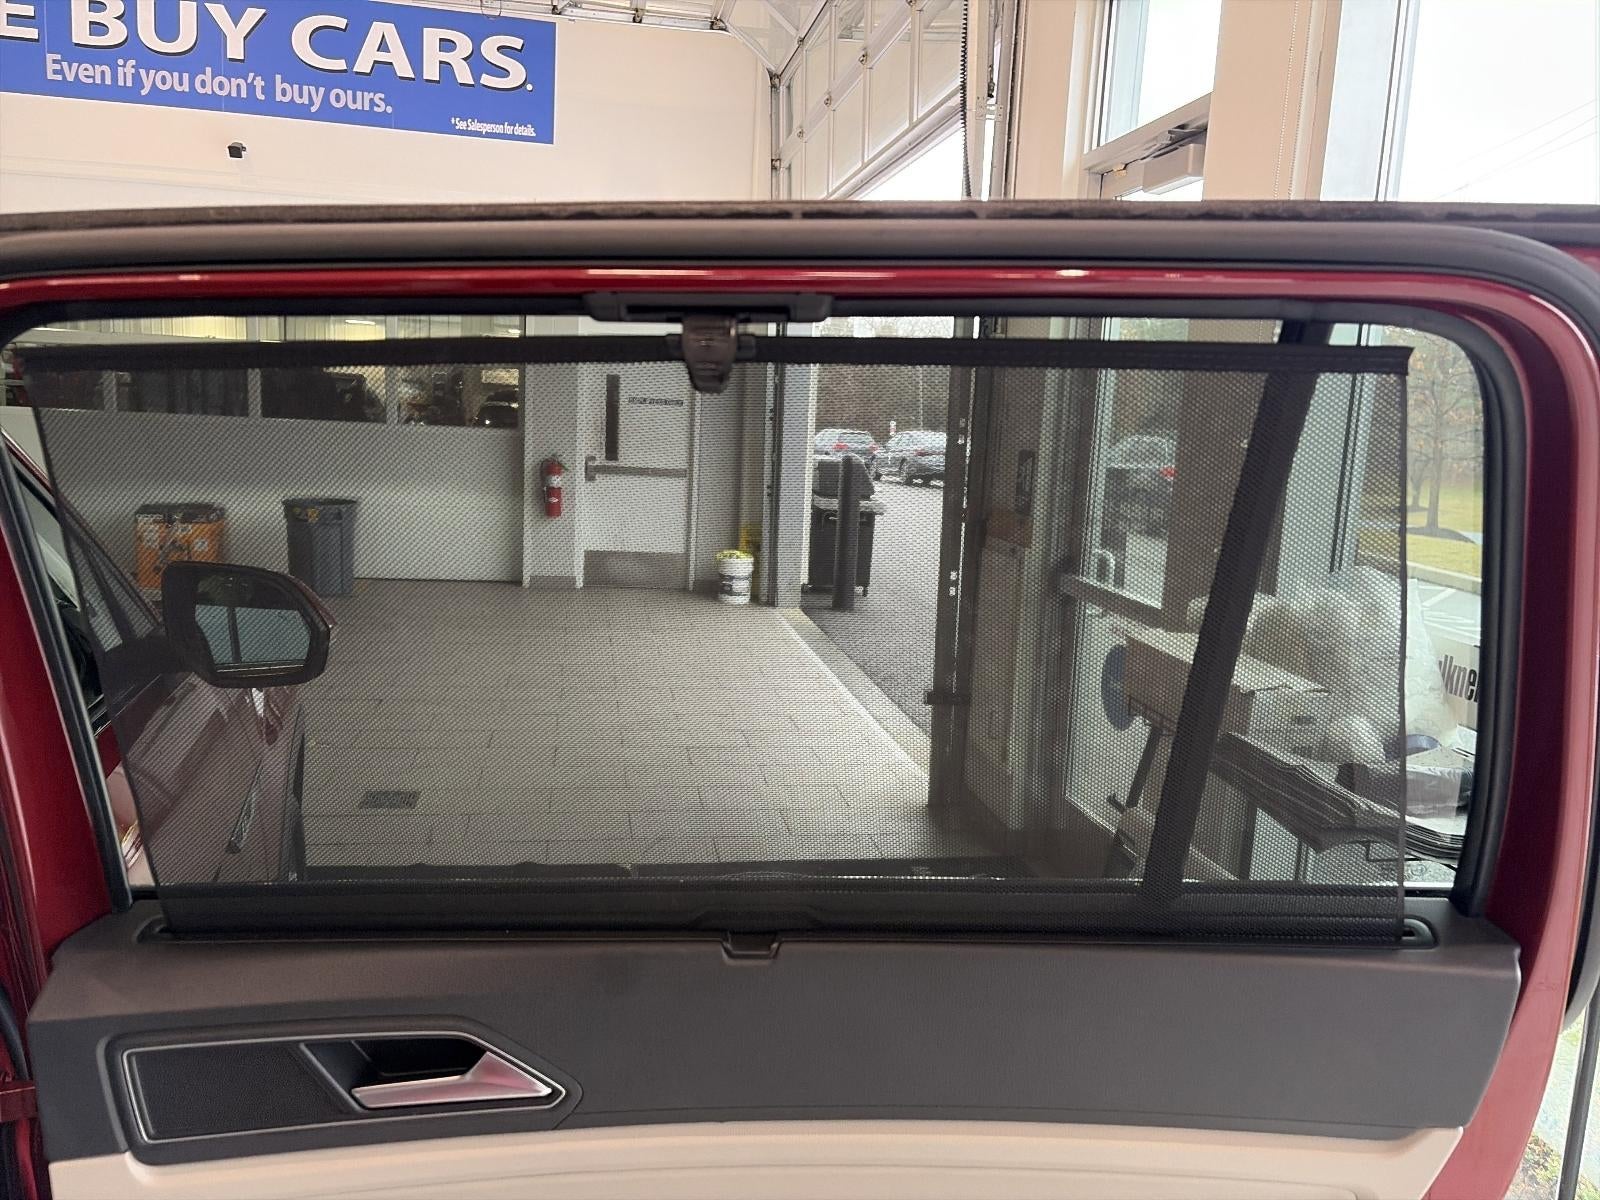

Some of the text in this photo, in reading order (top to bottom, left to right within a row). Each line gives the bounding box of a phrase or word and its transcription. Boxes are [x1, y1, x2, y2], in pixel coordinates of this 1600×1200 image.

[71, 0, 267, 62] BUY
[291, 14, 534, 91] CARS.
[46, 53, 393, 114] Even if you don’t buy ours.
[467, 118, 504, 135] Salesperson
[504, 121, 514, 135] for
[513, 123, 537, 137] details.
[1438, 654, 1479, 703] lkne
